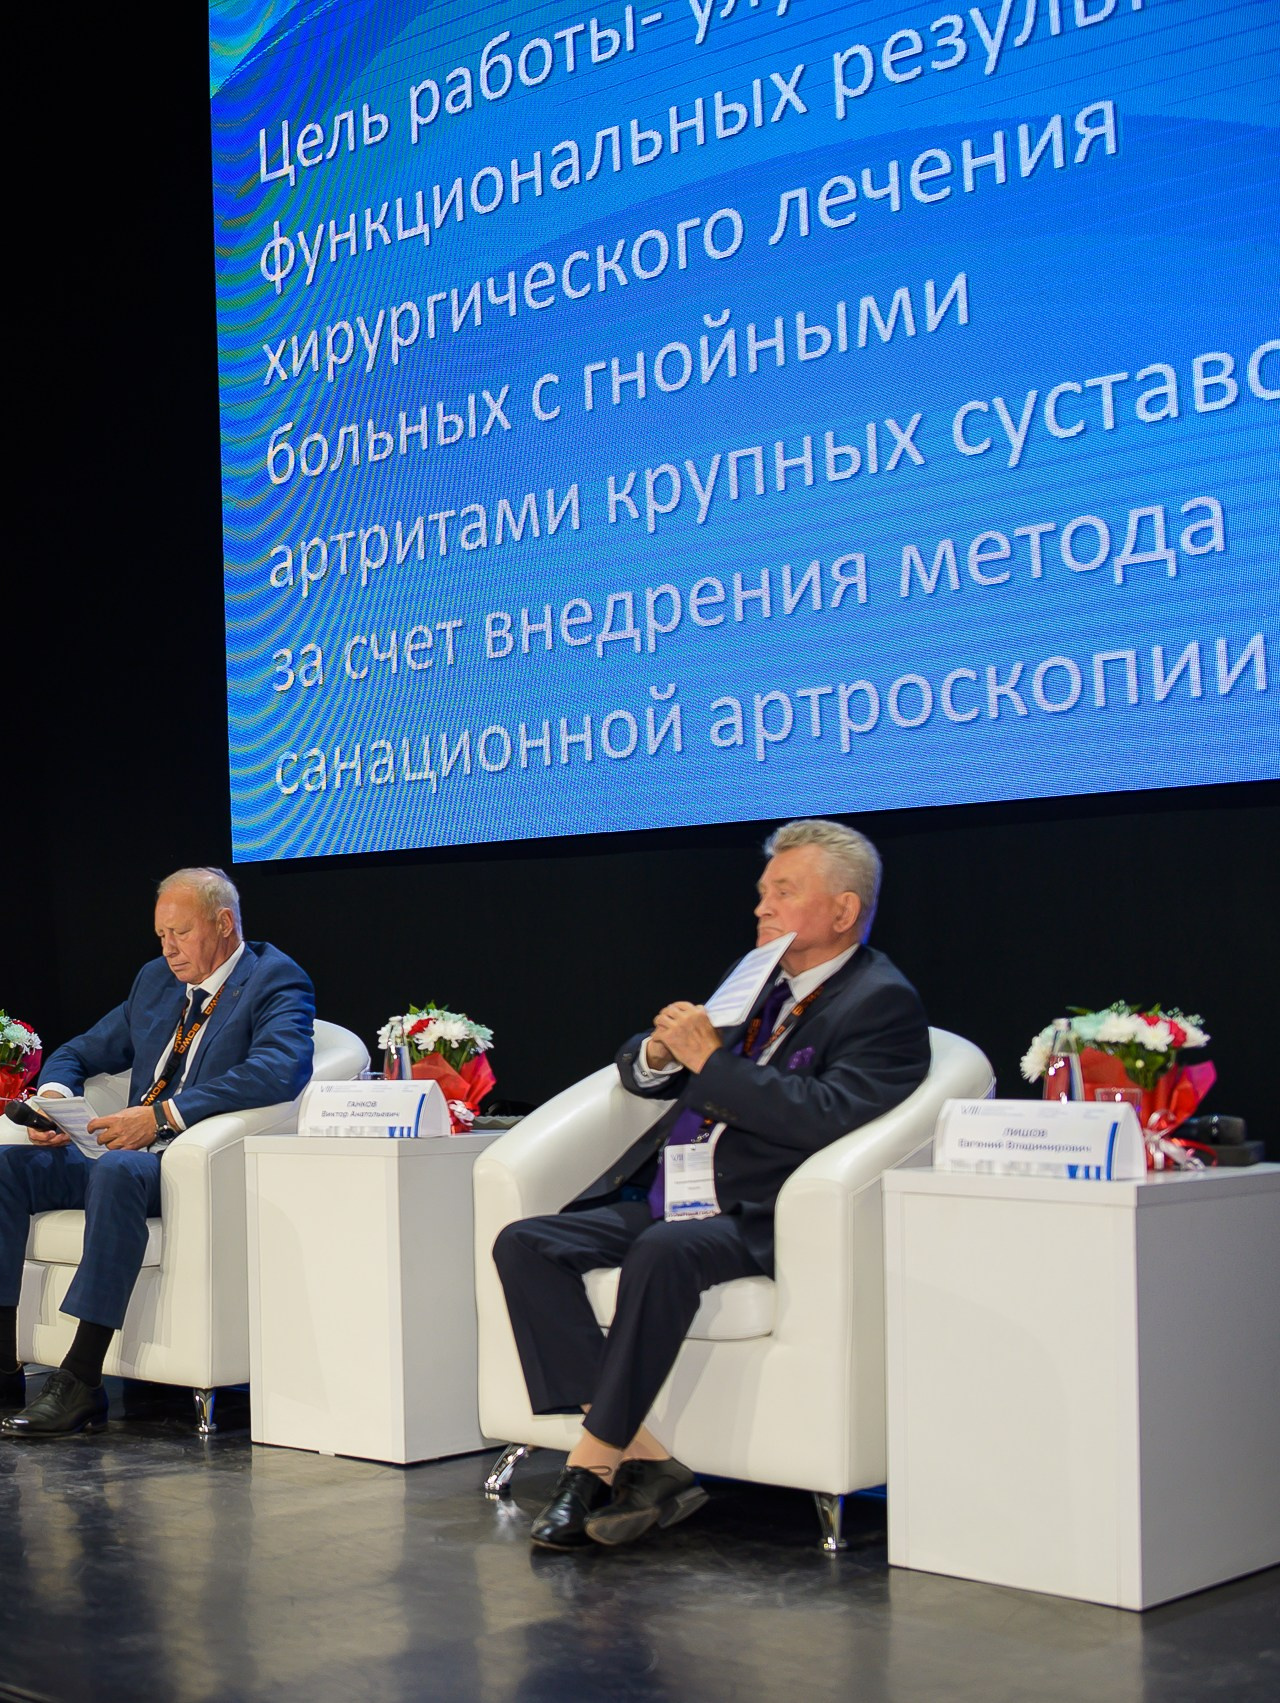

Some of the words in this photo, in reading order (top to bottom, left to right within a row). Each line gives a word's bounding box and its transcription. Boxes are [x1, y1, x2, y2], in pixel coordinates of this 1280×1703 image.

[259, 103, 389, 187] Цель
[259, 69, 808, 296] функциональных
[262, 207, 744, 386] хирургического
[768, 99, 1117, 245] лечения
[266, 384, 512, 486] больных
[531, 373, 561, 421] с
[583, 271, 970, 412] гнойными
[269, 483, 581, 598] артритами
[607, 412, 925, 533] крупных
[272, 642, 324, 692] за
[344, 618, 464, 680] счет
[485, 552, 868, 659] внедрения
[899, 495, 1226, 598] метода
[275, 683, 683, 795] санационной
[709, 632, 1268, 762] артроскопии
[178, 1022, 201, 1054] BOWA
